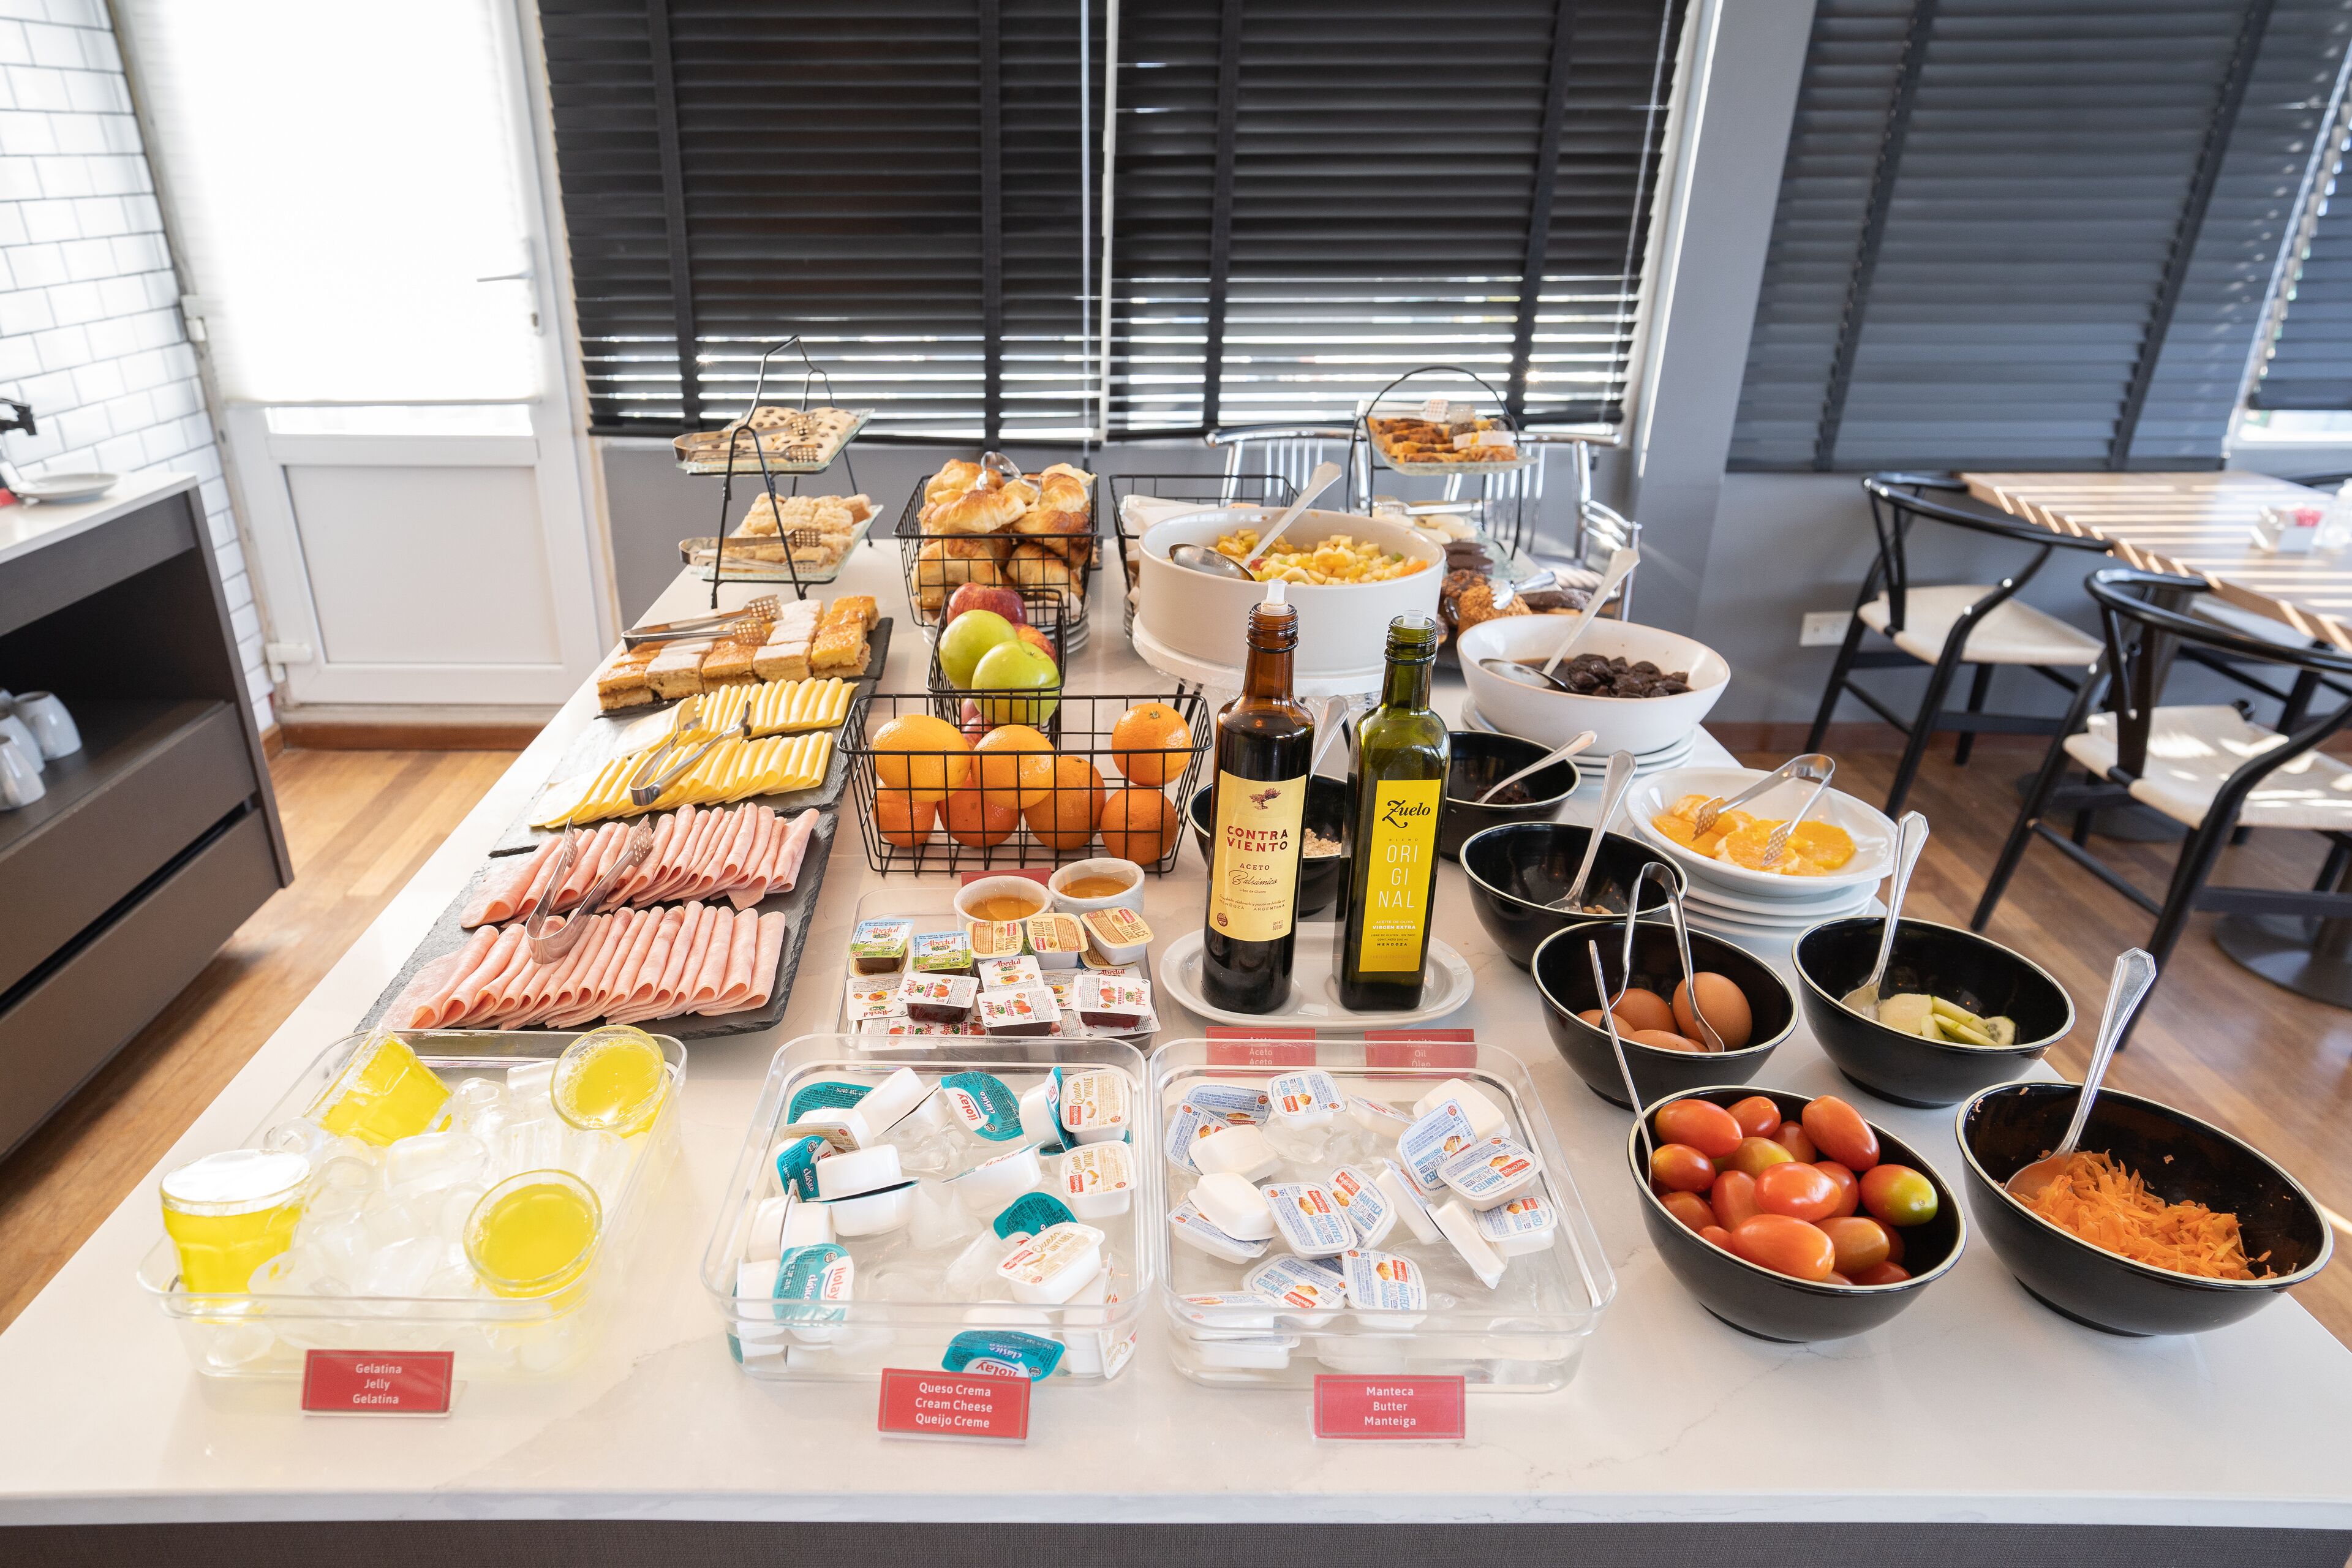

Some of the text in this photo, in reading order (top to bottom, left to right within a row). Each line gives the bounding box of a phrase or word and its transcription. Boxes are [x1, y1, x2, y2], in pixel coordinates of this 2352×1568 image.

[1382, 800, 1431, 828] Zuelo
[1227, 825, 1288, 840] CONTRA
[1226, 836, 1288, 852] VIENTO
[1387, 845, 1418, 863] ORI
[1229, 870, 1278, 885] Balsámico
[1391, 868, 1408, 886] GI
[1219, 899, 1245, 910] MENDOZA
[1378, 891, 1414, 908] NAL
[1032, 921, 1046, 937] DULCE
[1128, 922, 1148, 937] DULCE
[922, 938, 957, 946] Abedul
[992, 959, 1022, 968] Abedul
[904, 979, 918, 996] Abedul
[925, 982, 935, 998] FRUTILLA
[1134, 987, 1145, 1006] Abedul
[864, 1008, 894, 1017] Abedul
[982, 1000, 998, 1019] Abedul
[1411, 1058, 1431, 1068] Óleo
[1071, 1081, 1085, 1105] Queso
[957, 1093, 979, 1121] ilolay
[979, 1091, 996, 1114] clásico
[1071, 1155, 1085, 1174] Queso
[1414, 1147, 1442, 1167] PASTEURIZADA
[1428, 1153, 1447, 1170] CALIDAD
[1457, 1165, 1489, 1184] PASTEURIZADA
[1502, 1159, 1528, 1174] Verónica
[803, 1167, 815, 1192] clásico
[1338, 1174, 1357, 1193] Verónica
[1423, 1169, 1439, 1184] TECA
[1470, 1173, 1503, 1193] MANTECA
[1473, 1168, 1496, 1183] CALIDAD
[1311, 1190, 1326, 1213] Verónica
[1357, 1191, 1383, 1217] MANTECA
[1348, 1206, 1373, 1231] PASTEURIZADA
[1351, 1199, 1377, 1223] CALIDAD EXTRA
[1308, 1217, 1328, 1245] PASTEURIZADA
[1314, 1215, 1330, 1235] CALIDAD
[1324, 1215, 1344, 1243] MANTECA
[1033, 1231, 1061, 1253] Queso
[1048, 1232, 1076, 1252] UNTABLE
[804, 1274, 818, 1300] clásico
[827, 1267, 846, 1299] ilolay
[1256, 1277, 1285, 1295] MANTECA
[1287, 1294, 1313, 1308] Verónica
[1398, 1283, 1410, 1310] MANTECA
[989, 1347, 1022, 1359] clásico
[355, 1363, 402, 1374] Gelatina
[364, 1379, 390, 1391] Jelly
[919, 1382, 991, 1397] Queso Crema
[1366, 1387, 1414, 1396] Manteca
[352, 1394, 399, 1404] Gelatina
[915, 1398, 993, 1412] Cream Cheese
[1373, 1401, 1408, 1411] Butter
[916, 1413, 990, 1428] Queijo Creme
[1364, 1416, 1417, 1428] Manteiga
